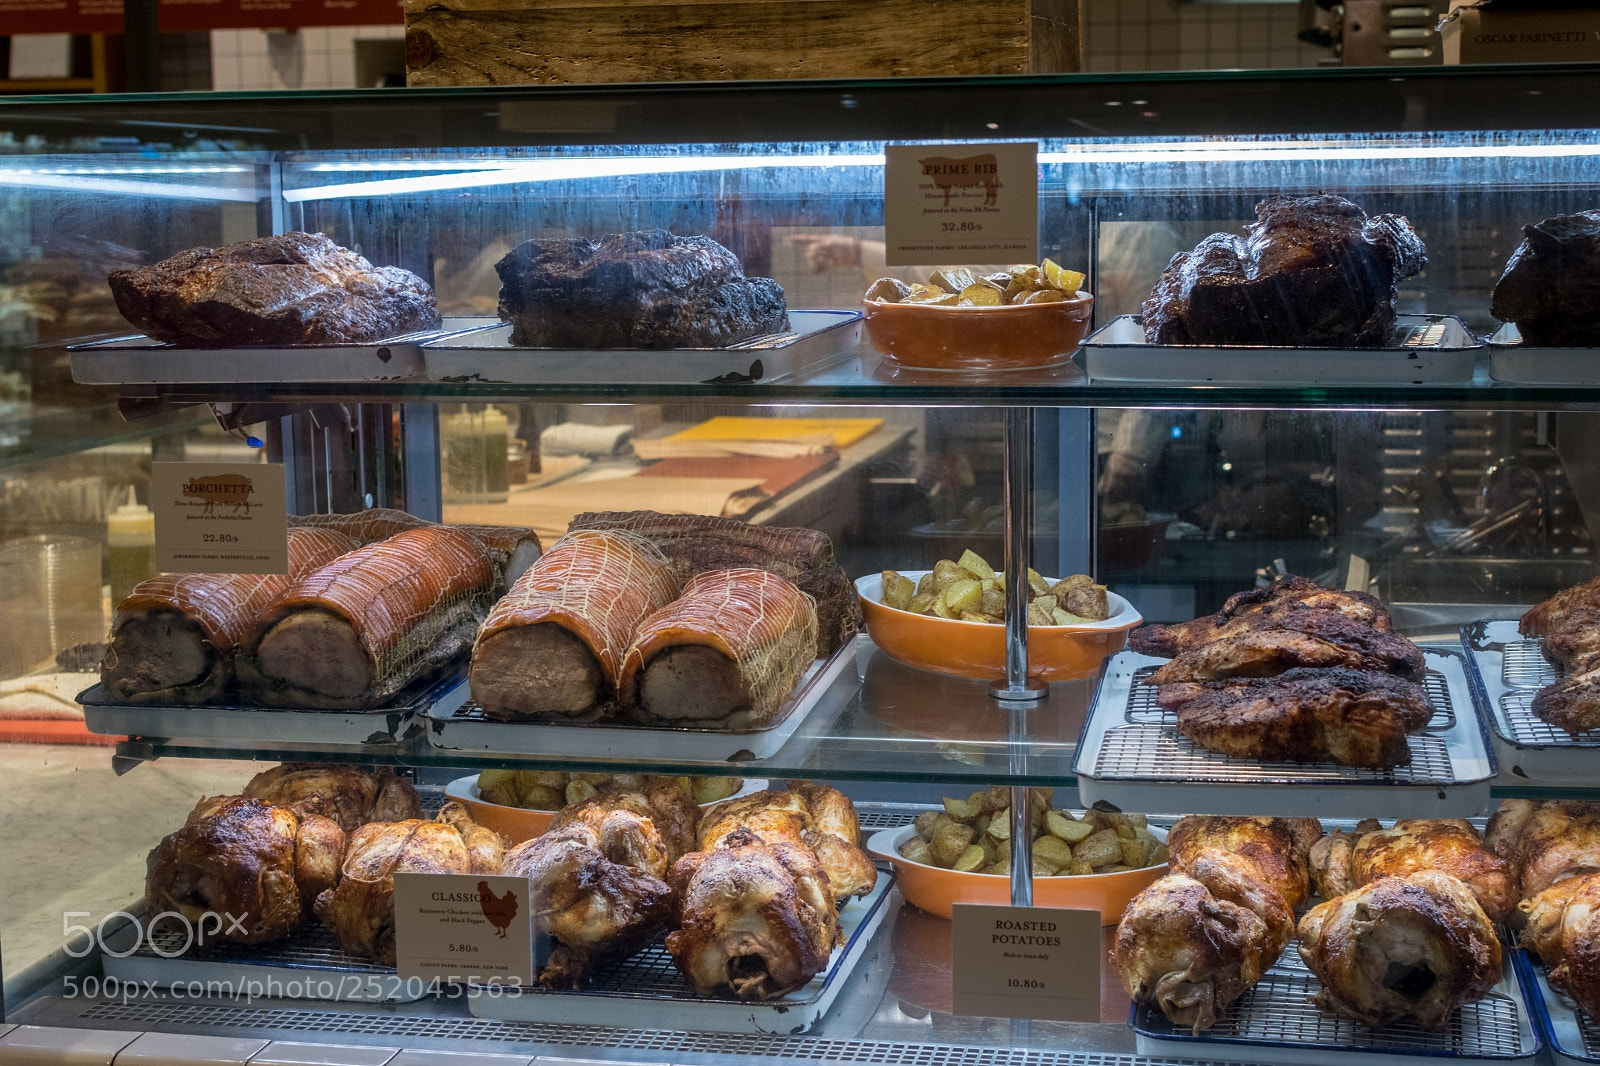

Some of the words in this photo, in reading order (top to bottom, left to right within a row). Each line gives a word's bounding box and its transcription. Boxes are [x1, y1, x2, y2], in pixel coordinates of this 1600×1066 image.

[1475, 34, 1516, 44] OSCAR
[1519, 31, 1586, 43] FARINETTI
[926, 165, 969, 175] PRIME
[974, 164, 997, 174] RIB
[183, 484, 255, 493] PORCHETTA
[432, 892, 491, 903] CLASSICO
[466, 917, 485, 925] Pepper
[996, 920, 1057, 931] ROASTED
[992, 934, 1061, 946] POTATOES
